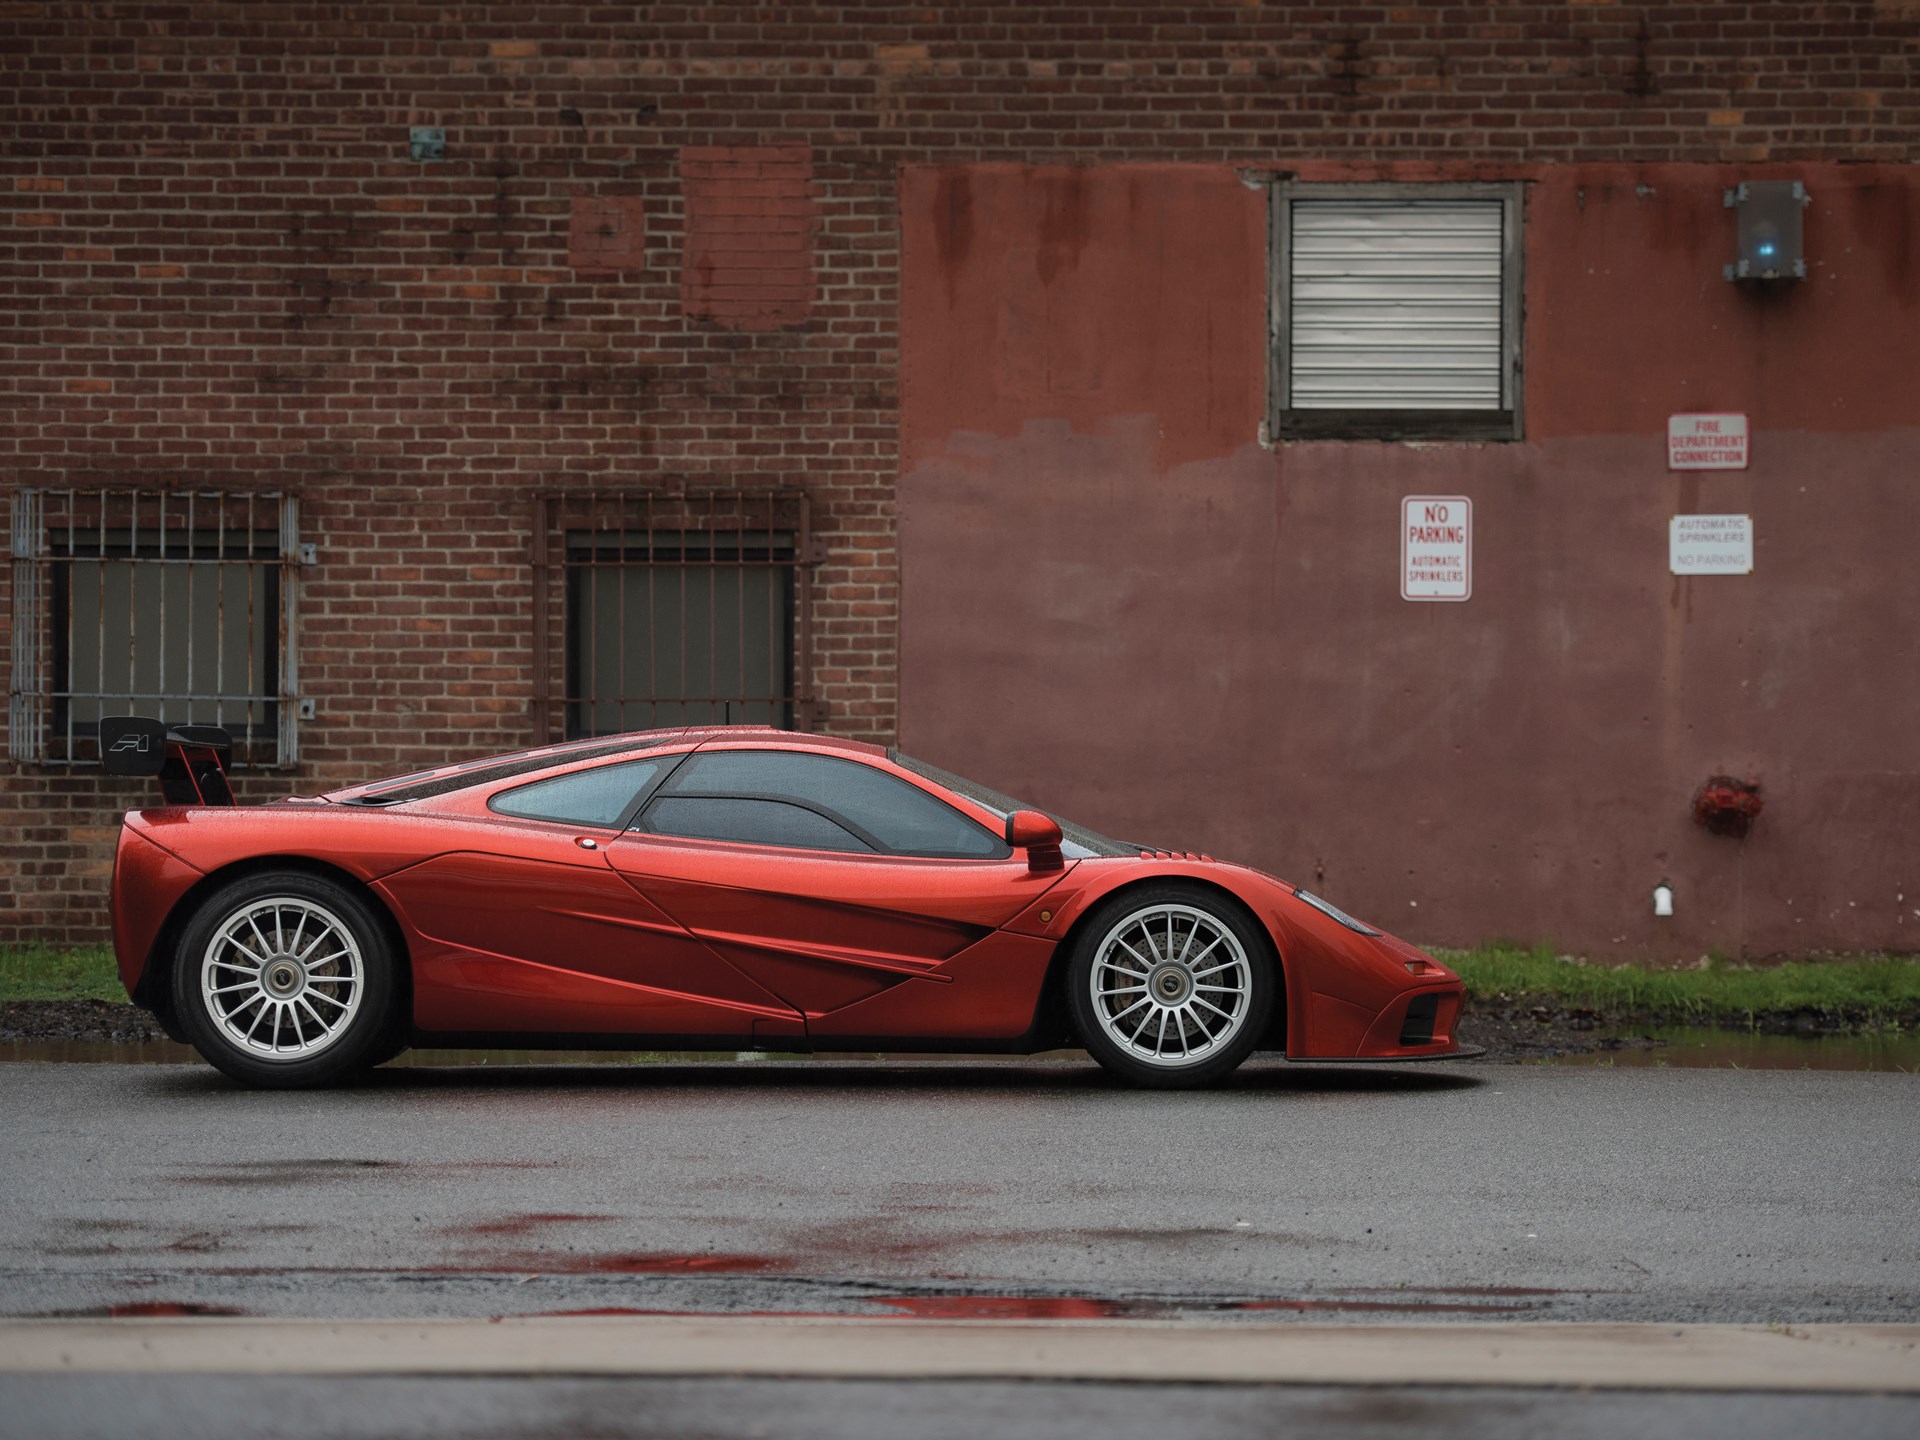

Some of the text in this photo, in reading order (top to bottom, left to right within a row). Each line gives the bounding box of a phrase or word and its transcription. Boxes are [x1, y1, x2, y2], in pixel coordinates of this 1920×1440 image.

[1695, 420, 1720, 433] FIRE
[1671, 436, 1745, 448] DEPARTMENT
[1673, 450, 1743, 463] CONNECTION
[1424, 506, 1449, 523] NO
[1678, 519, 1745, 529] AUTOMATIC
[1409, 526, 1464, 544] PARKING
[1678, 532, 1745, 543] SPRINKLERS
[1411, 555, 1462, 566] AUTOMATIC
[1677, 554, 1746, 566] NO PARKING
[1408, 570, 1463, 582] SPRINKLERS
